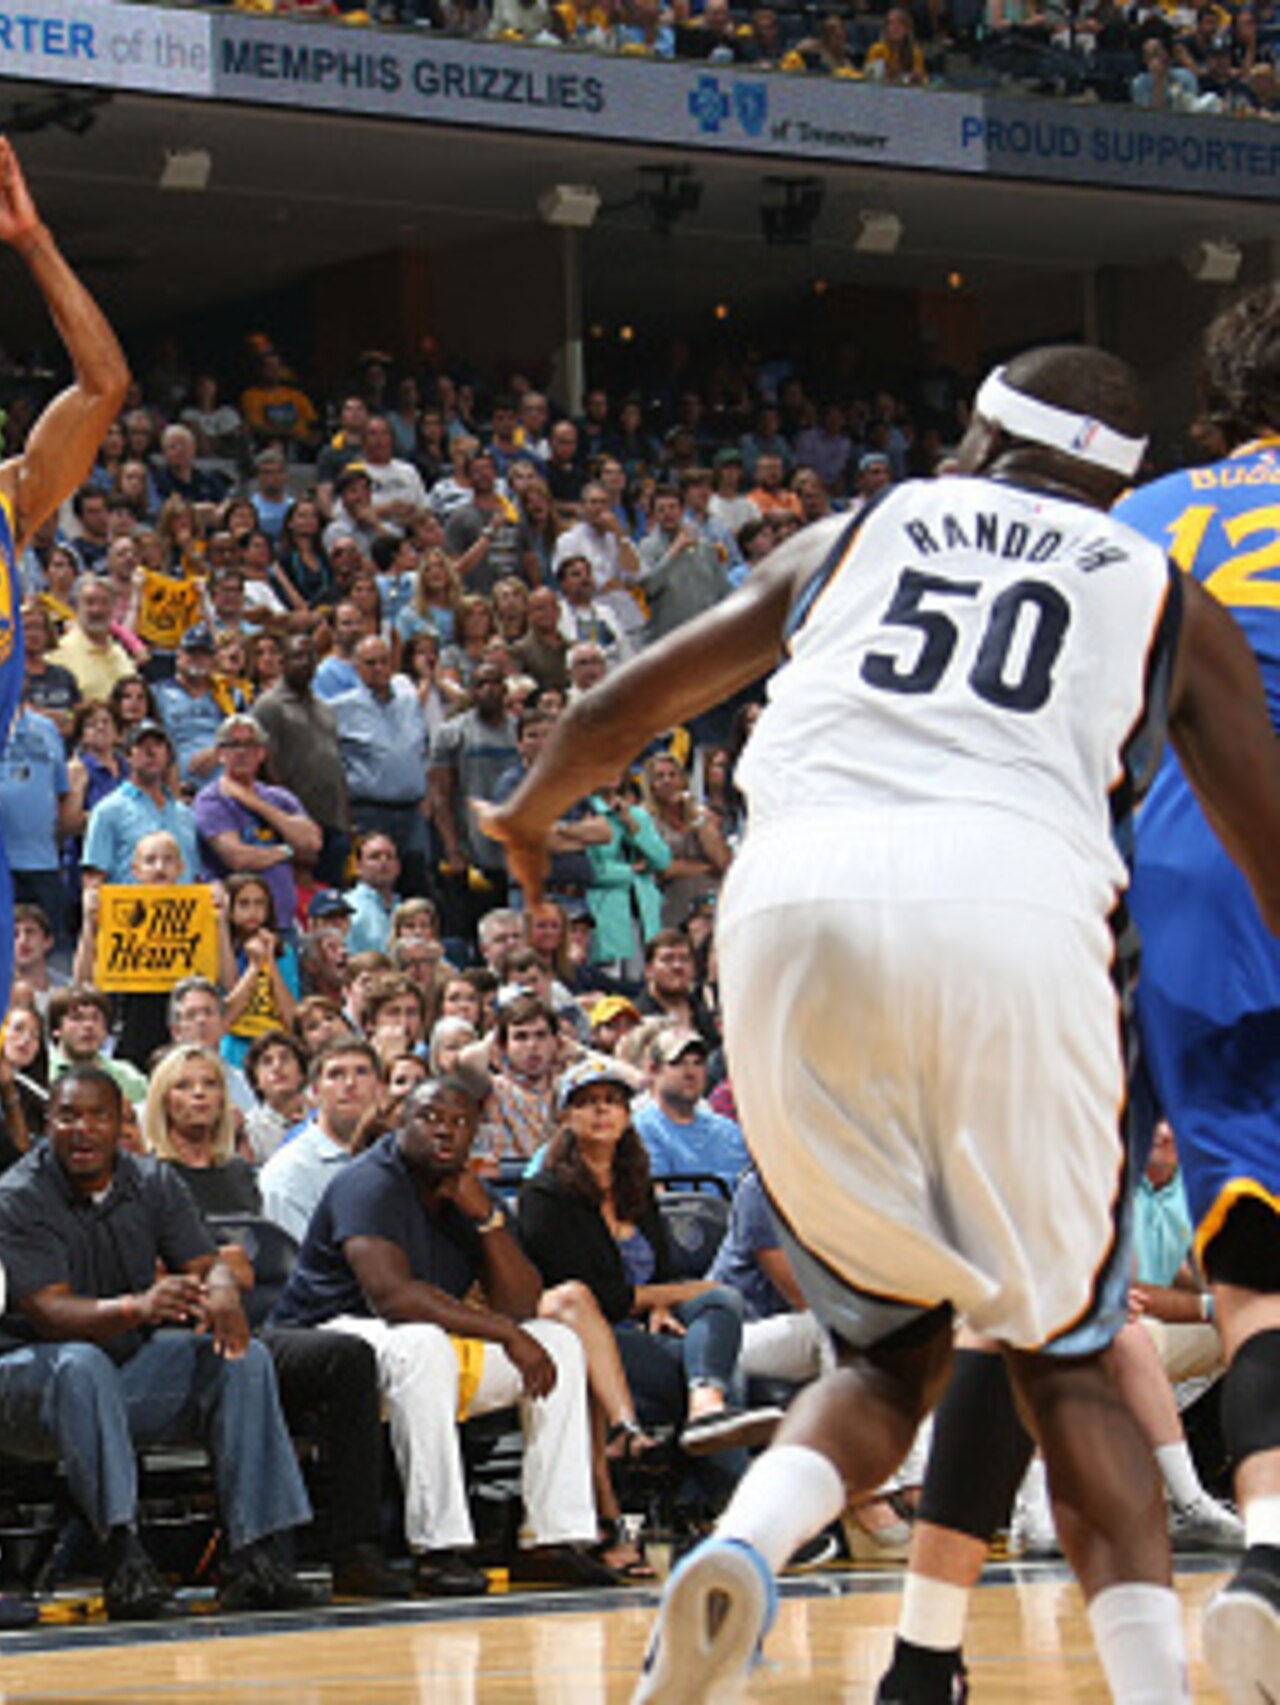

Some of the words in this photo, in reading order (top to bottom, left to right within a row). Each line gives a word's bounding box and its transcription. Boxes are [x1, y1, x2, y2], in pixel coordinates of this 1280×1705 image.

[111, 28, 143, 65] of
[154, 33, 207, 72] the
[222, 39, 402, 92] MEMPHIS
[412, 59, 606, 114] GRIZZLIES
[961, 116, 1082, 158] PROUD
[1165, 504, 1280, 610] 12
[859, 567, 1072, 714] 50
